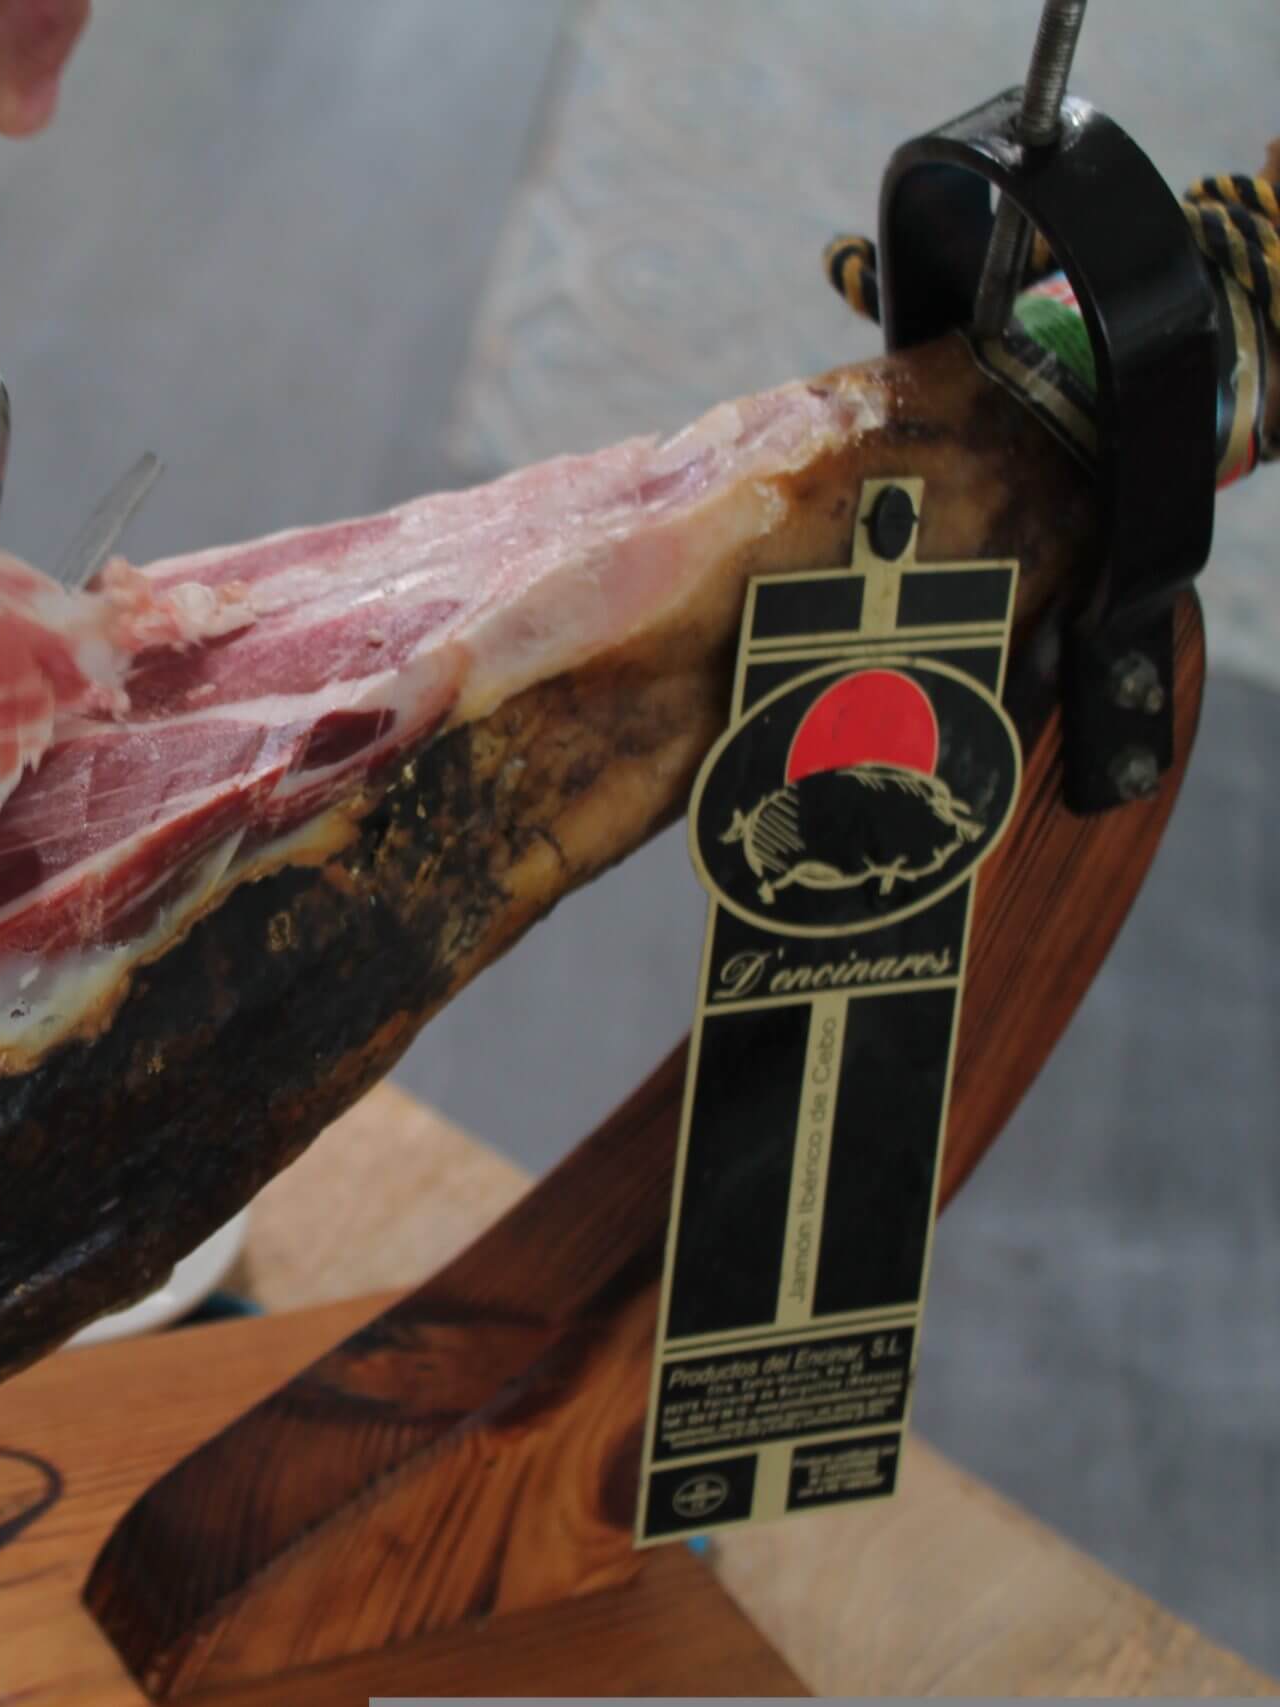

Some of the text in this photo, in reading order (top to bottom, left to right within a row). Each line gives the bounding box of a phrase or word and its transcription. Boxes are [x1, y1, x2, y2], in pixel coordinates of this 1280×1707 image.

[811, 1016, 838, 1086] Cebo
[809, 1092, 829, 1124] de
[668, 1360, 758, 1391] Productos
[762, 1350, 794, 1375] del
